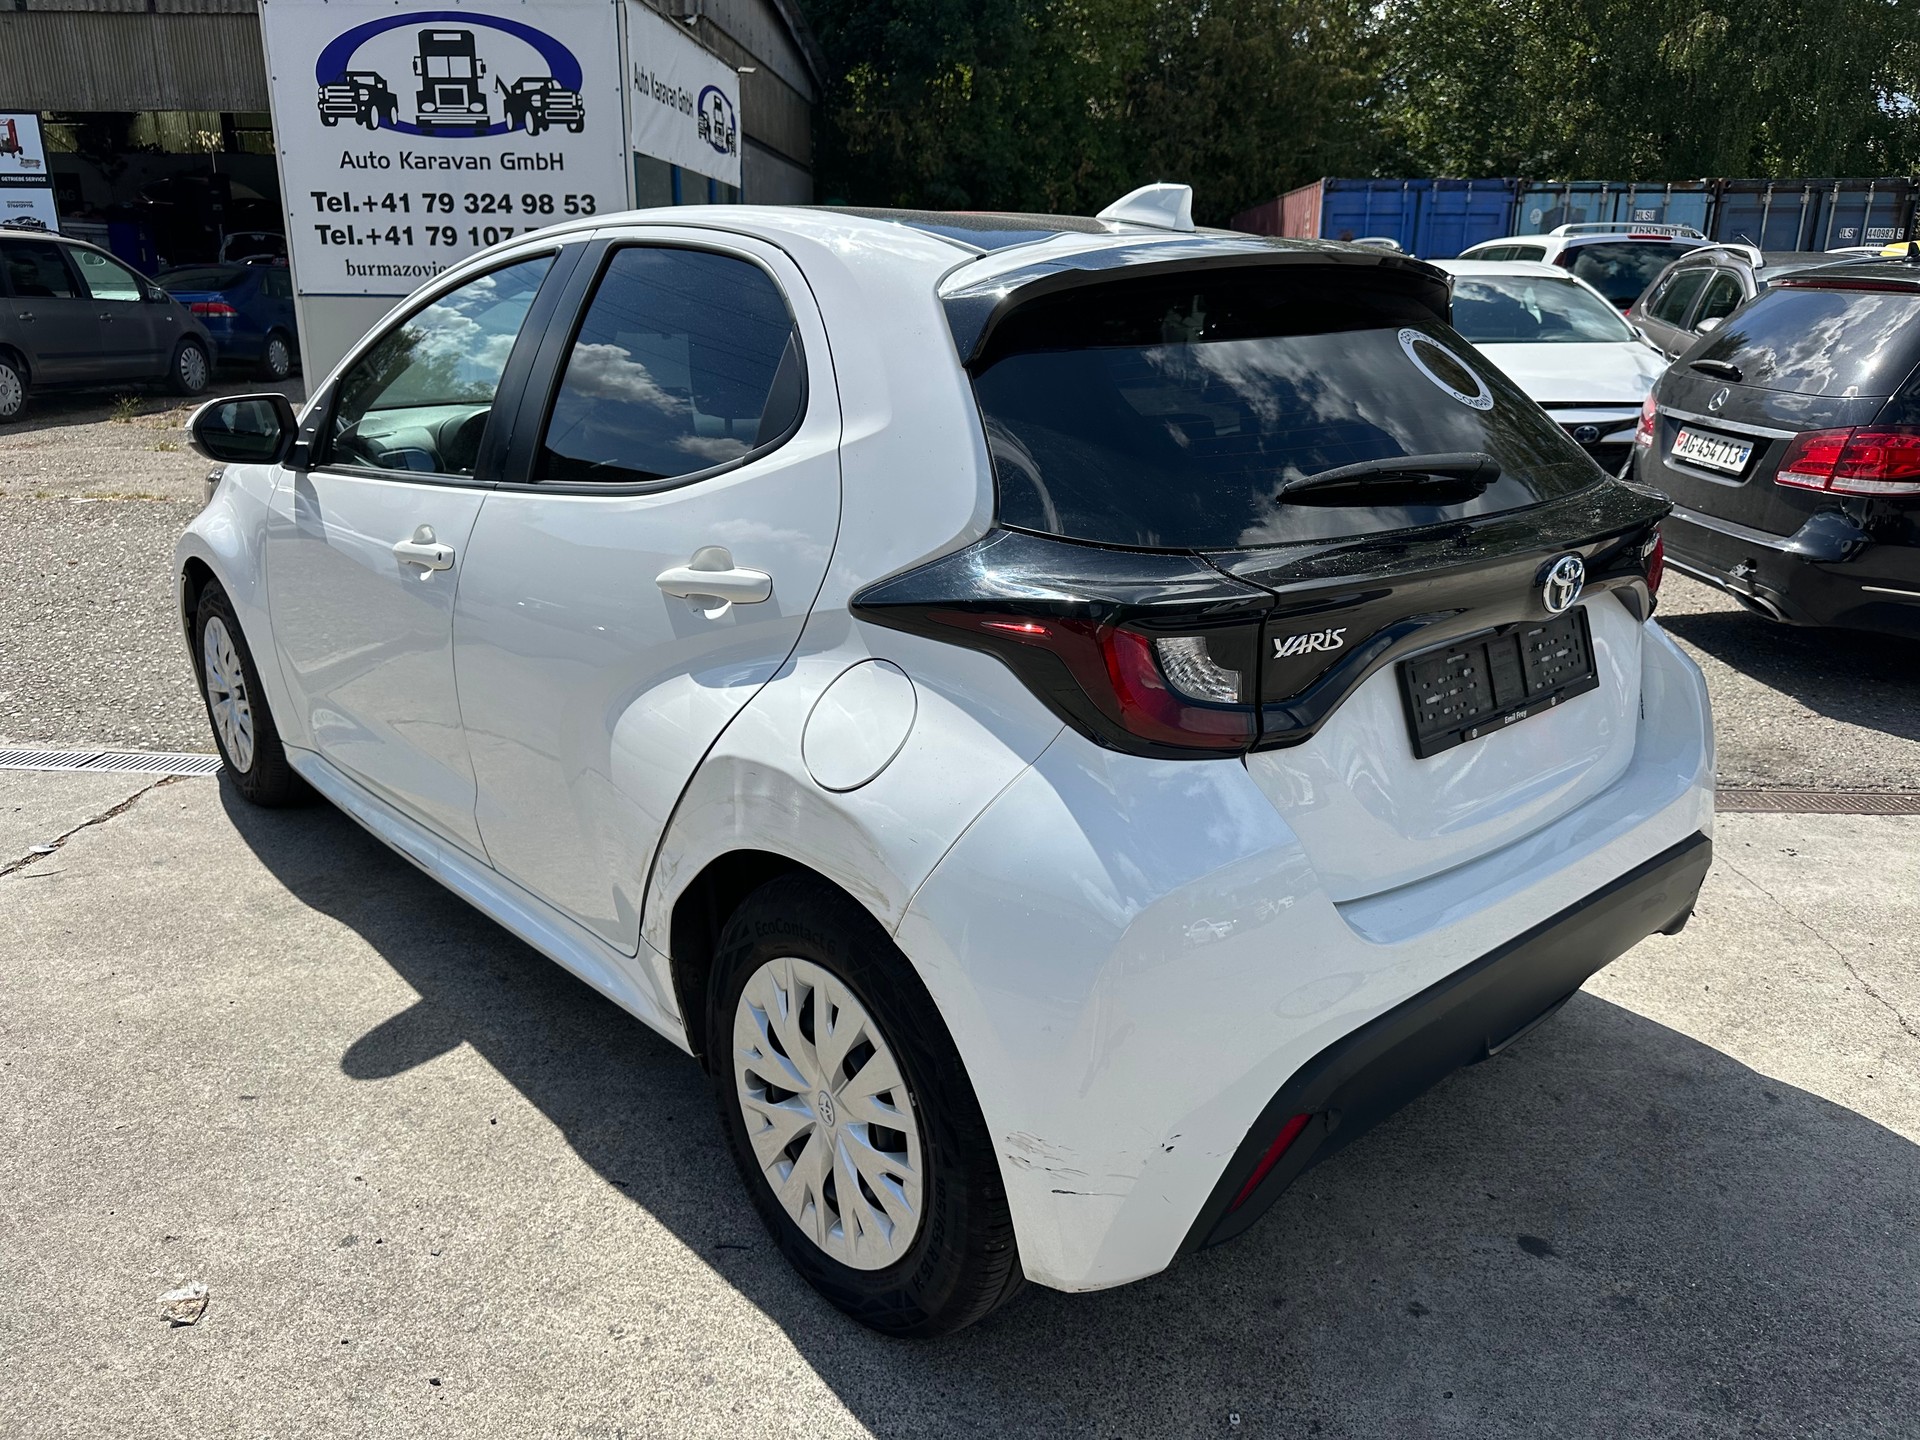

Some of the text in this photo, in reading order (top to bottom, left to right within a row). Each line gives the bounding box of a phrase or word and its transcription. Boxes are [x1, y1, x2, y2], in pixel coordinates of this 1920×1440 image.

[634, 62, 694, 118] Auto Karavan GmbH
[339, 151, 564, 171] Auto Karavan GmbH
[310, 191, 597, 215] Tel.+41 79 324 98 53
[314, 225, 514, 247] Tel.+41 79 107
[1897, 228, 1905, 239] 5
[345, 259, 452, 277] burmazovic
[1453, 391, 1493, 408] COMPANY
[1273, 627, 1348, 659] YARIS
[1504, 712, 1516, 724] Emil
[755, 917, 825, 950] EcoContact
[932, 1175, 947, 1247] 185/65
